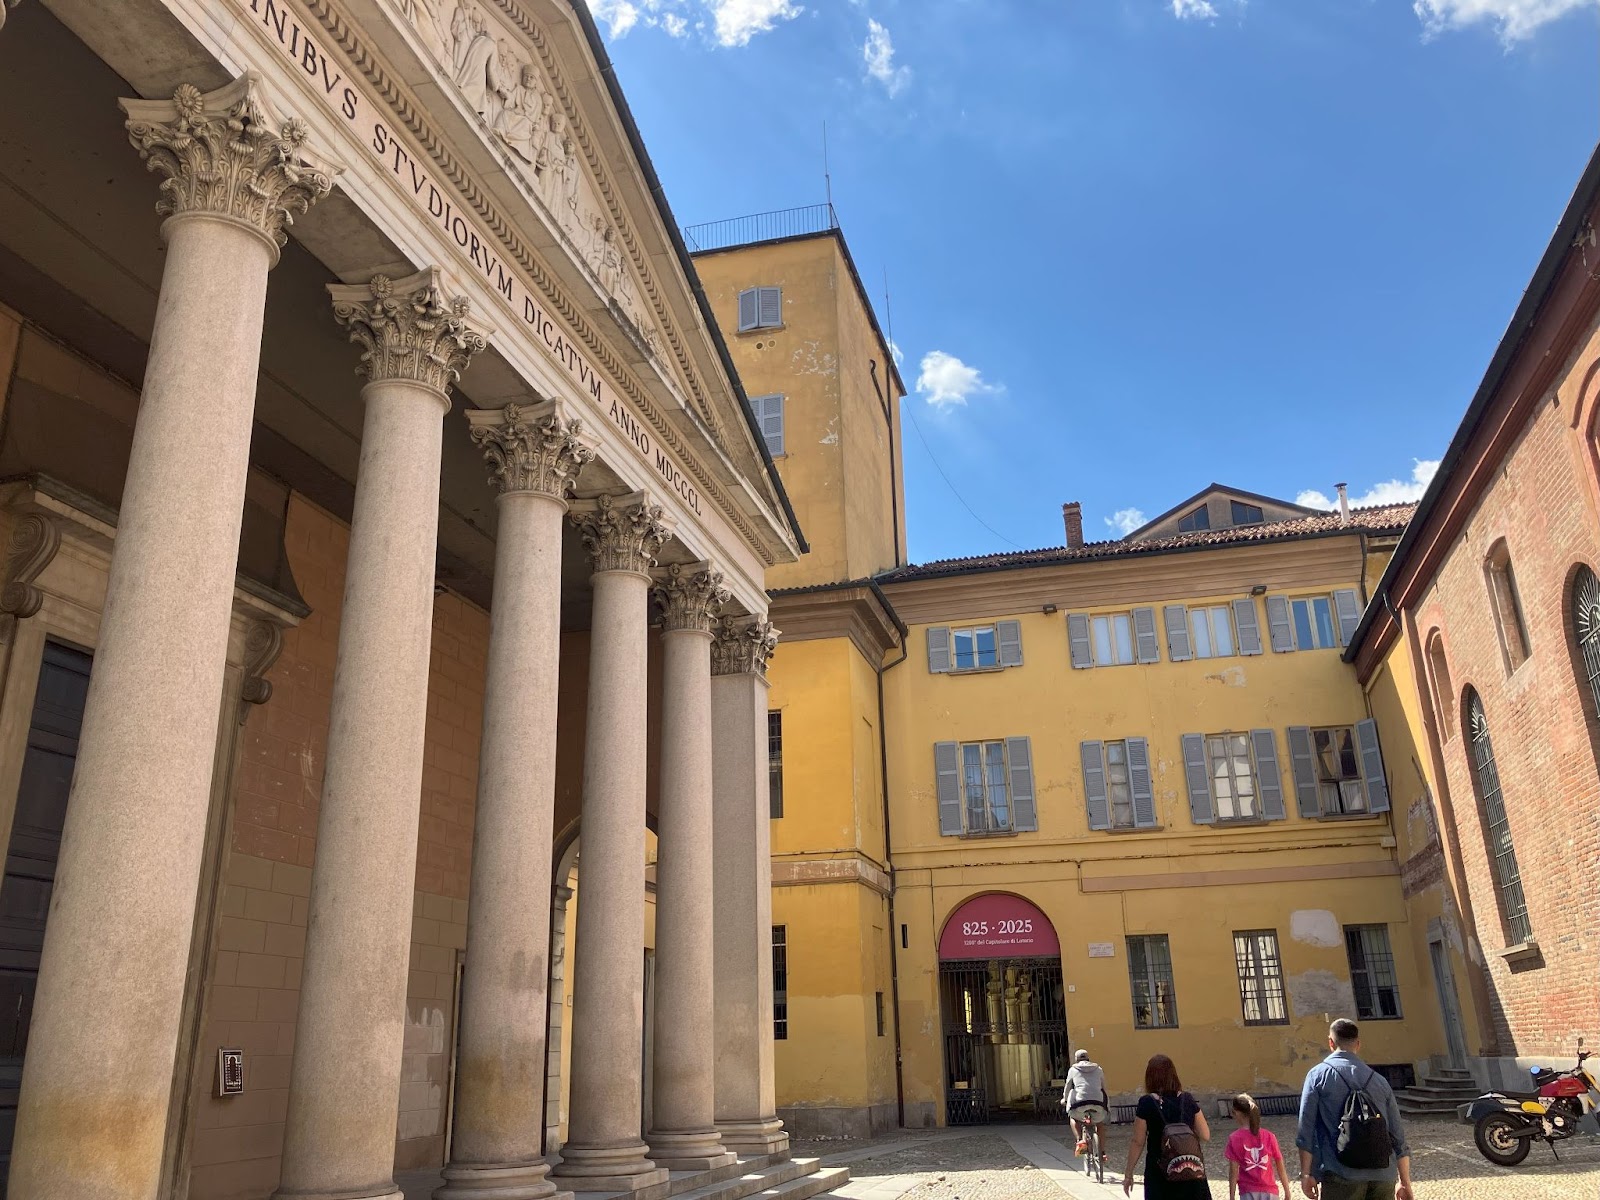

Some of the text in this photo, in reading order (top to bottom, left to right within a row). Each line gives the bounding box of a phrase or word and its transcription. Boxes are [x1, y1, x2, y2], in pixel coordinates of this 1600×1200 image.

[373, 123, 513, 302] STVDIORVM
[523, 296, 602, 402] DICATVM
[609, 399, 650, 455] ANNO
[655, 448, 702, 516] MDCCCL
[962, 922, 988, 935] 825
[998, 920, 1033, 934] 2025
